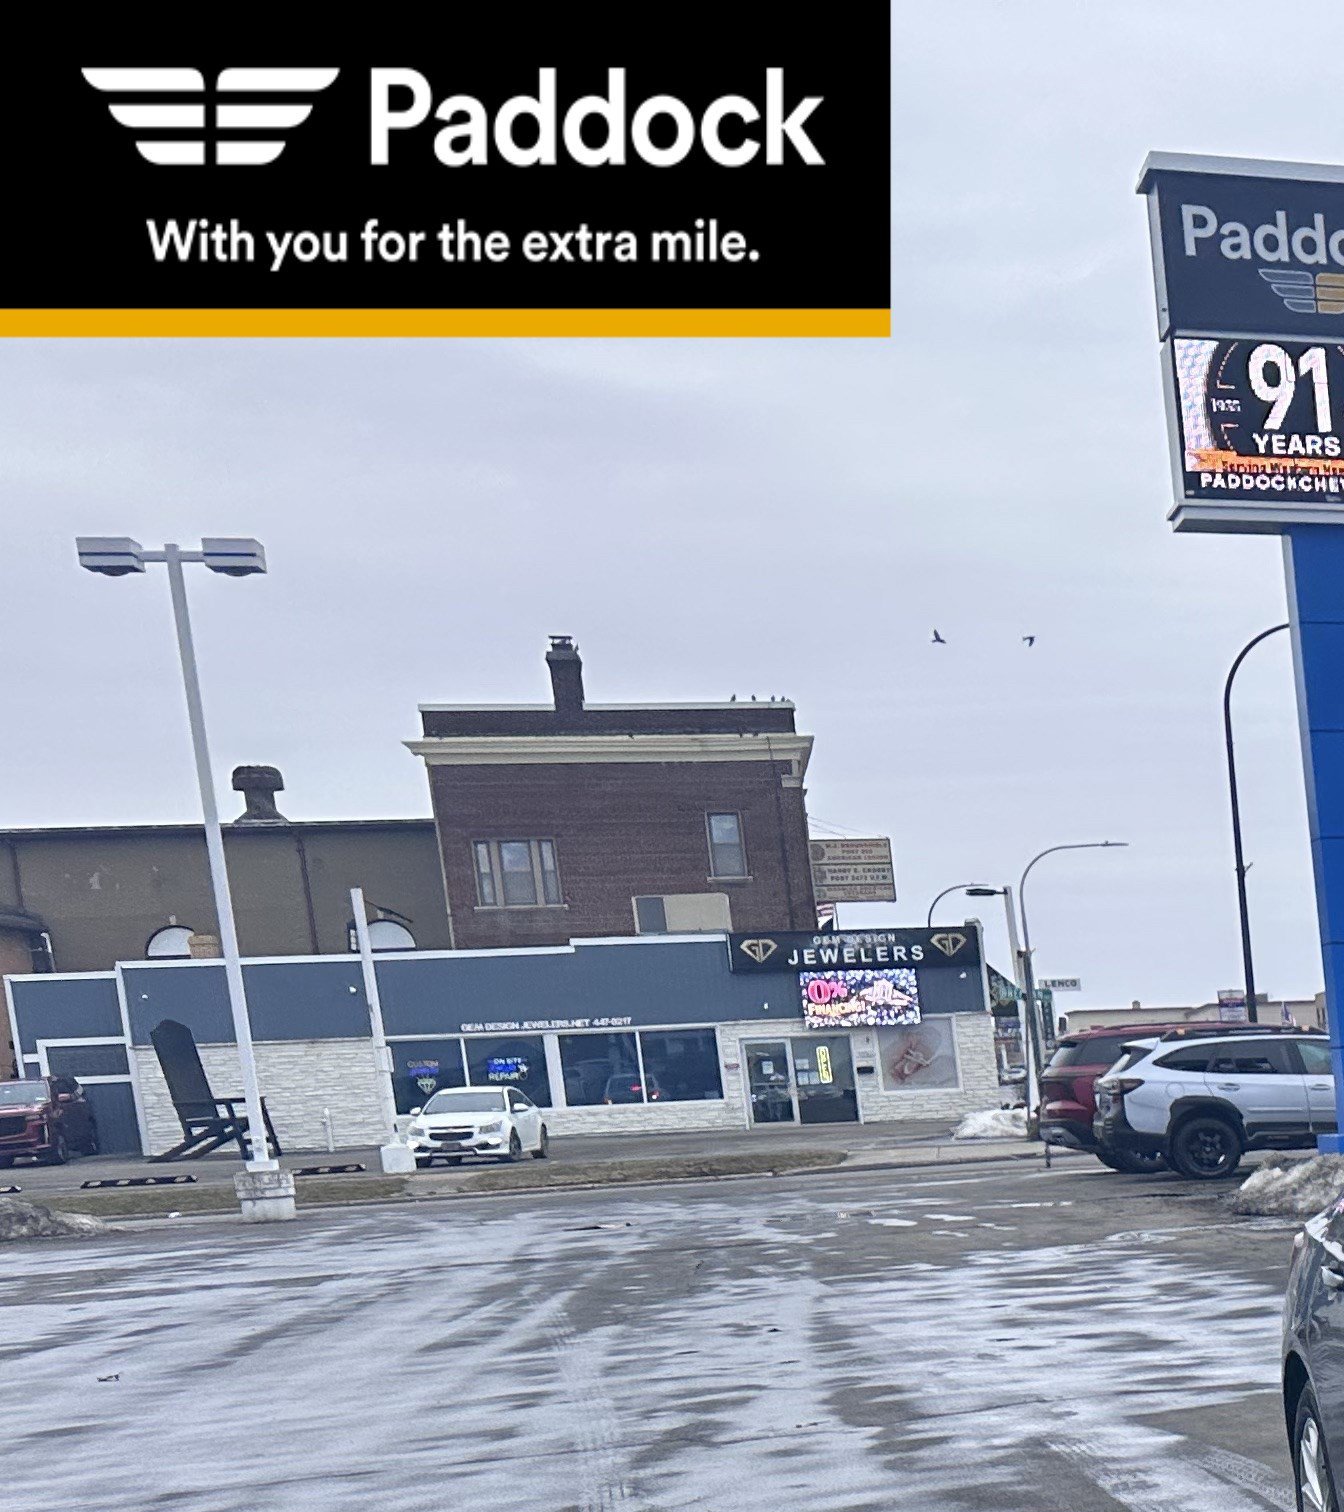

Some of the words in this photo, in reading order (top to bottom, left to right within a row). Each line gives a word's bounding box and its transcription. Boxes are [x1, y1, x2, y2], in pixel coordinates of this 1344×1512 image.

[1248, 343, 1332, 432] 91
[1252, 433, 1341, 456] YEARS
[788, 945, 924, 966] JEWELERS
[807, 979, 848, 1004] 0%
